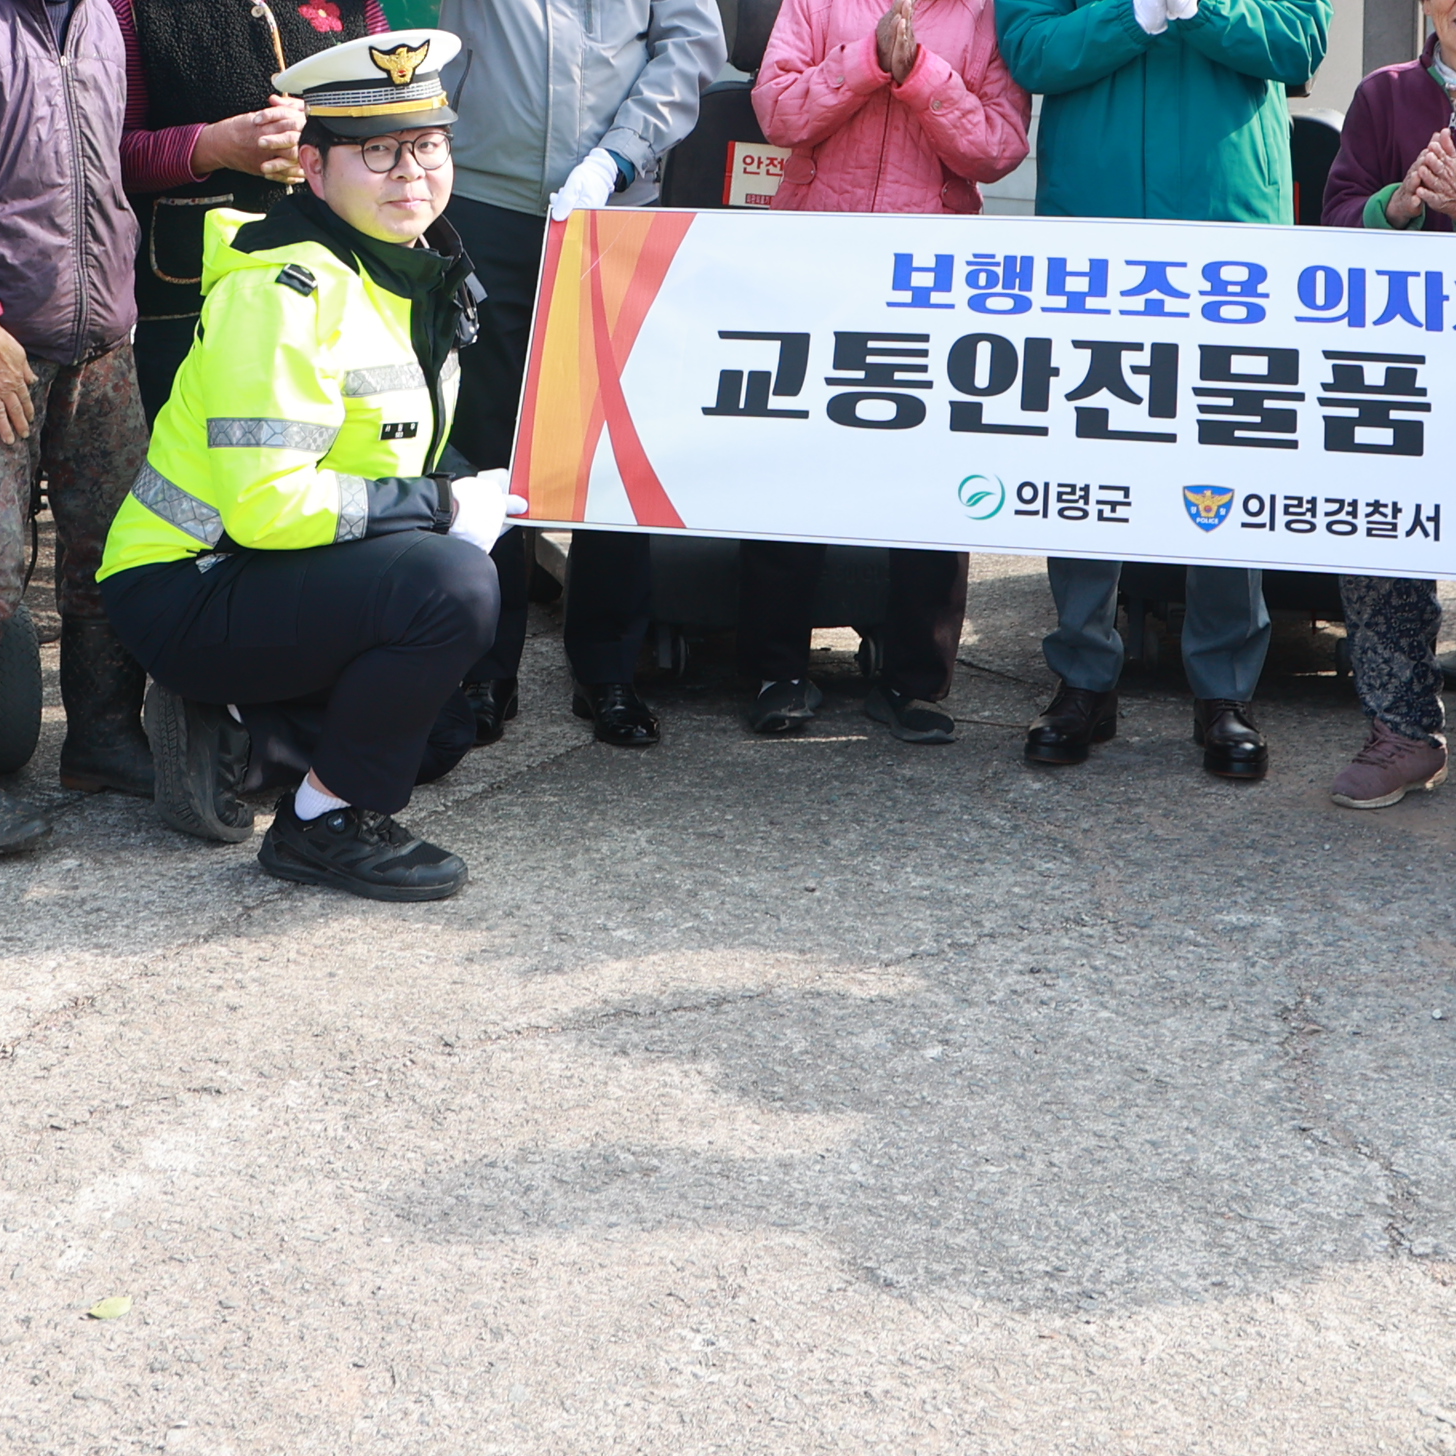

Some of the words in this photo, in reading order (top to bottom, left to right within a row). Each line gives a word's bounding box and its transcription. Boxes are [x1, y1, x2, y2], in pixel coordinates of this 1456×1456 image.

[885, 252, 1271, 326] 보행보조용
[700, 330, 1434, 458] 교통안전물품
[1014, 480, 1133, 526] 의령군
[1196, 517, 1219, 525] POLICE
[1240, 493, 1442, 543] 의령경찰서
